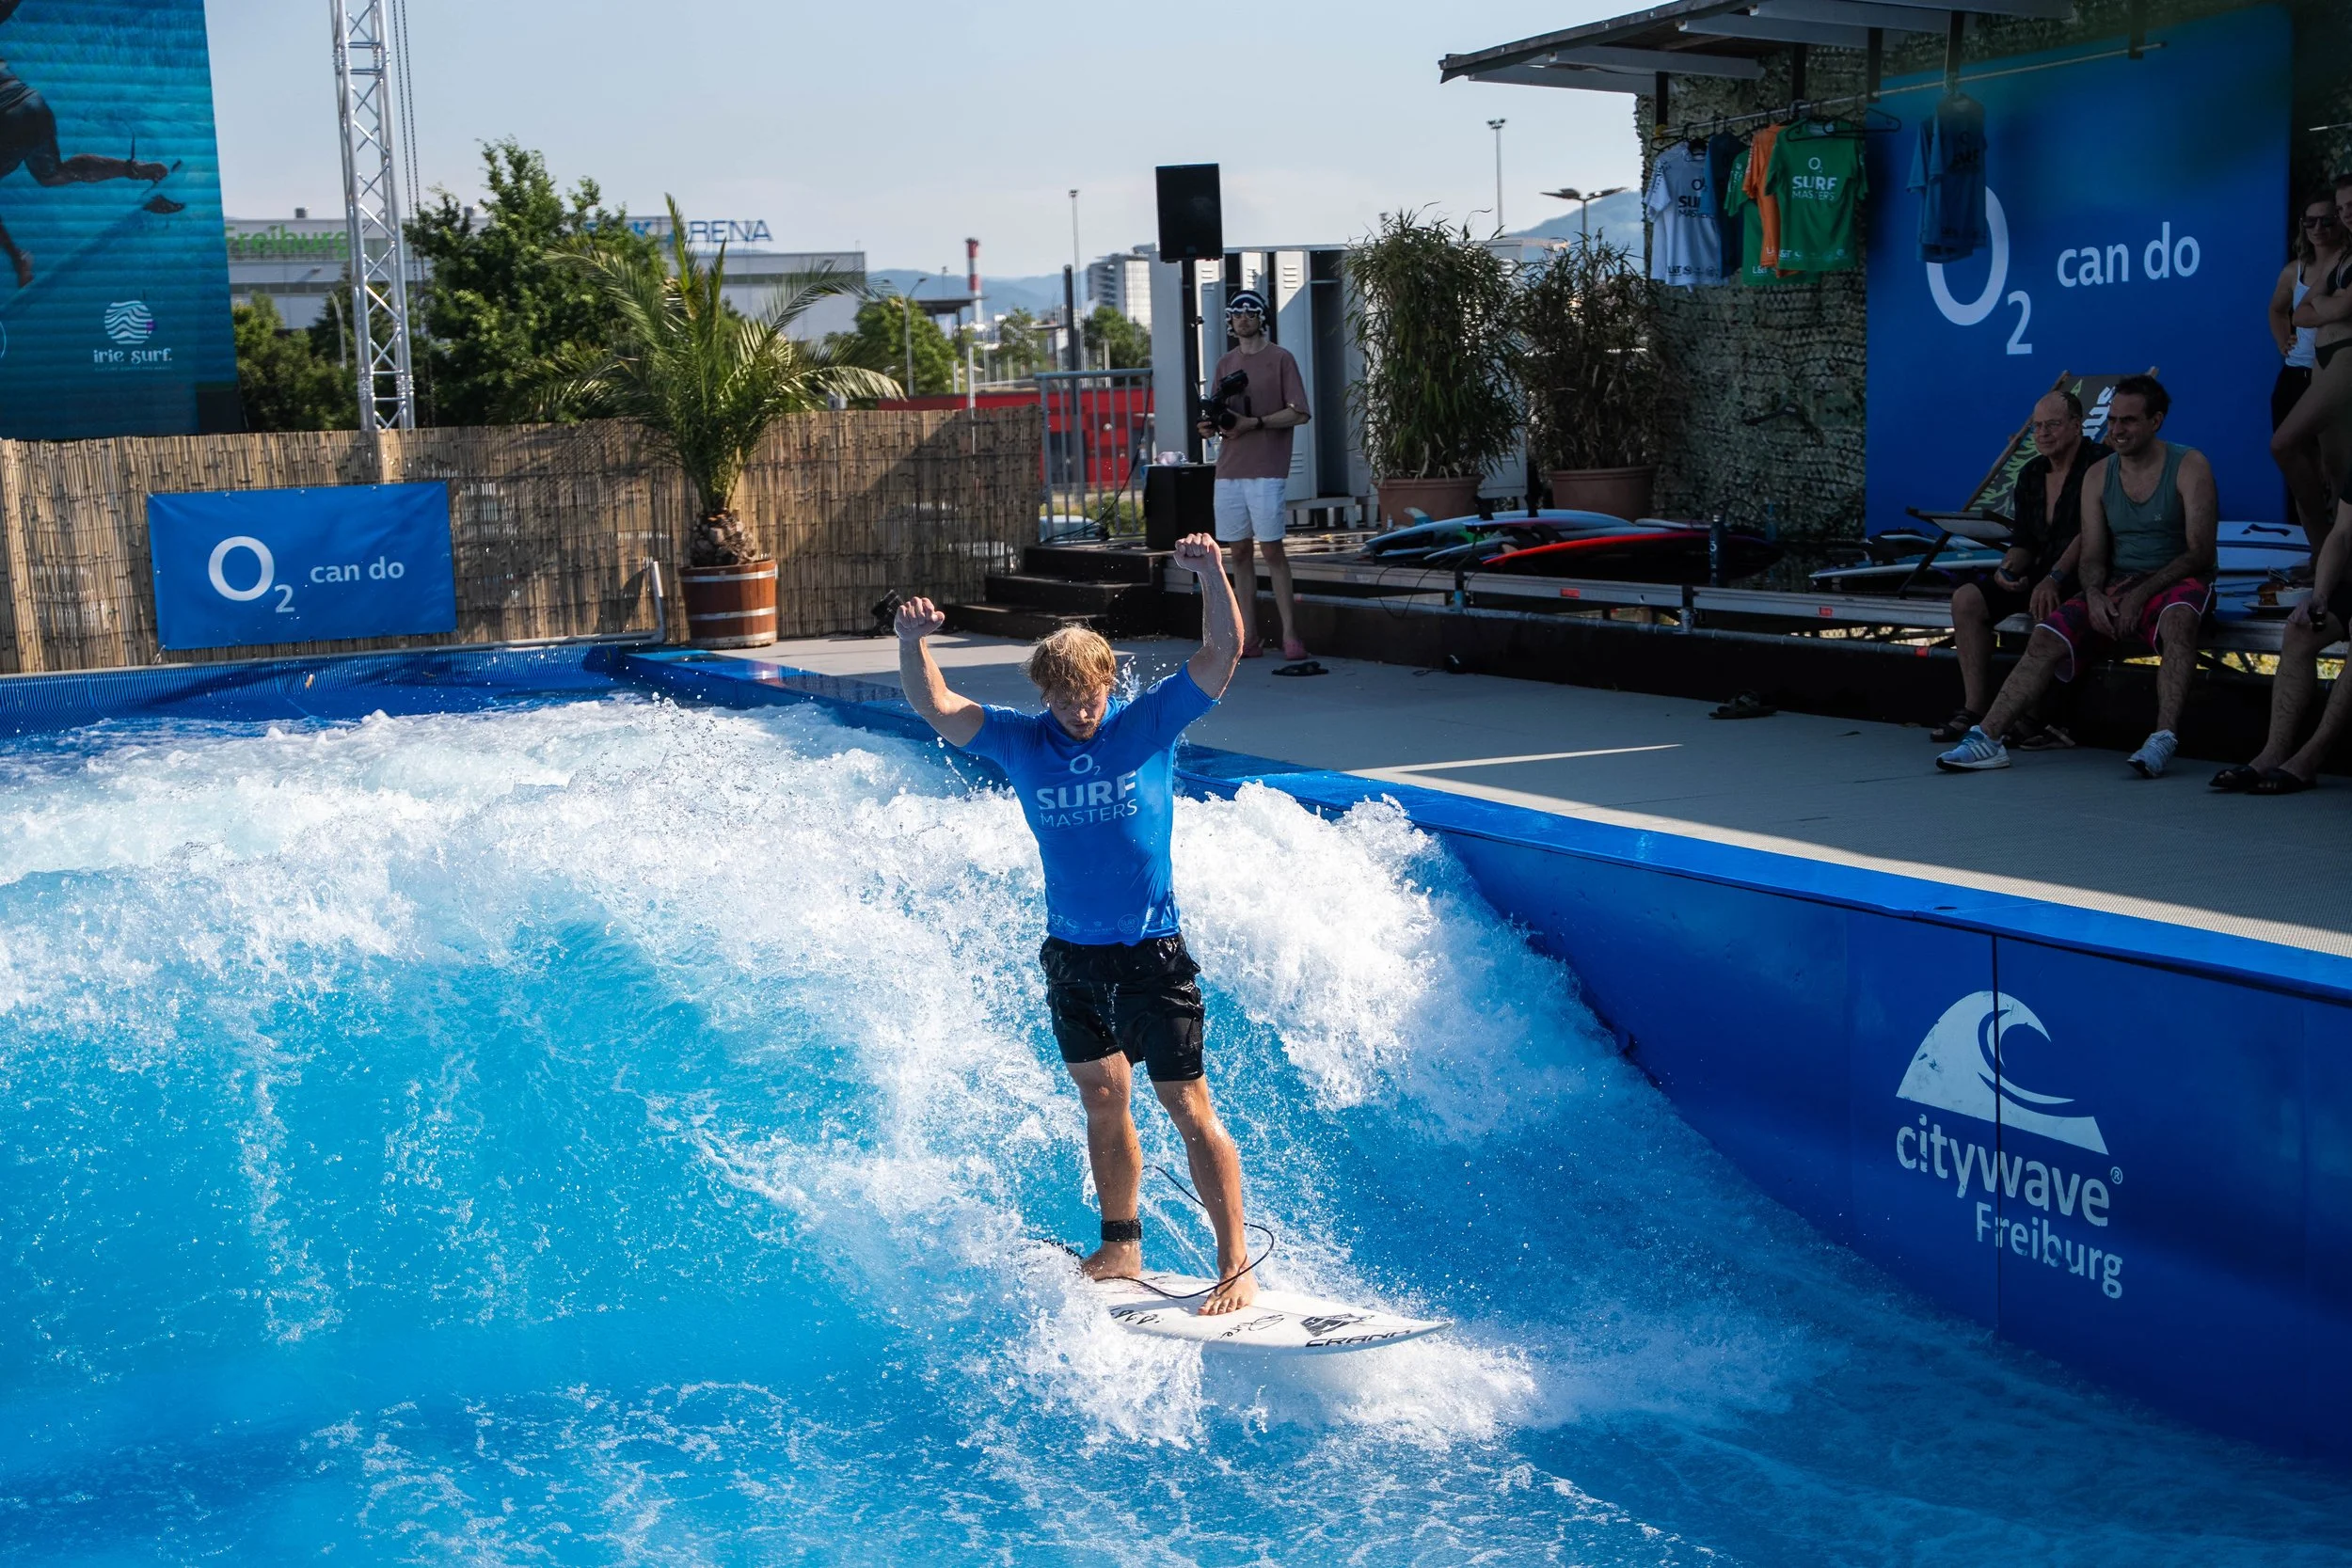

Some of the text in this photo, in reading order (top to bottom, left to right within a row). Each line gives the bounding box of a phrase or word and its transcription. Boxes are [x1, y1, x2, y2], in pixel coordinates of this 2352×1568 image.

[1792, 175, 1837, 191] SURF
[2057, 244, 2129, 288] can
[2143, 221, 2201, 280] do
[93, 349, 125, 363] irie
[310, 563, 360, 583] can
[368, 556, 405, 580] do
[1036, 769, 1137, 810] SURF
[1040, 799, 1137, 828] MASTERS
[1976, 1201, 2123, 1299] Freiburg
